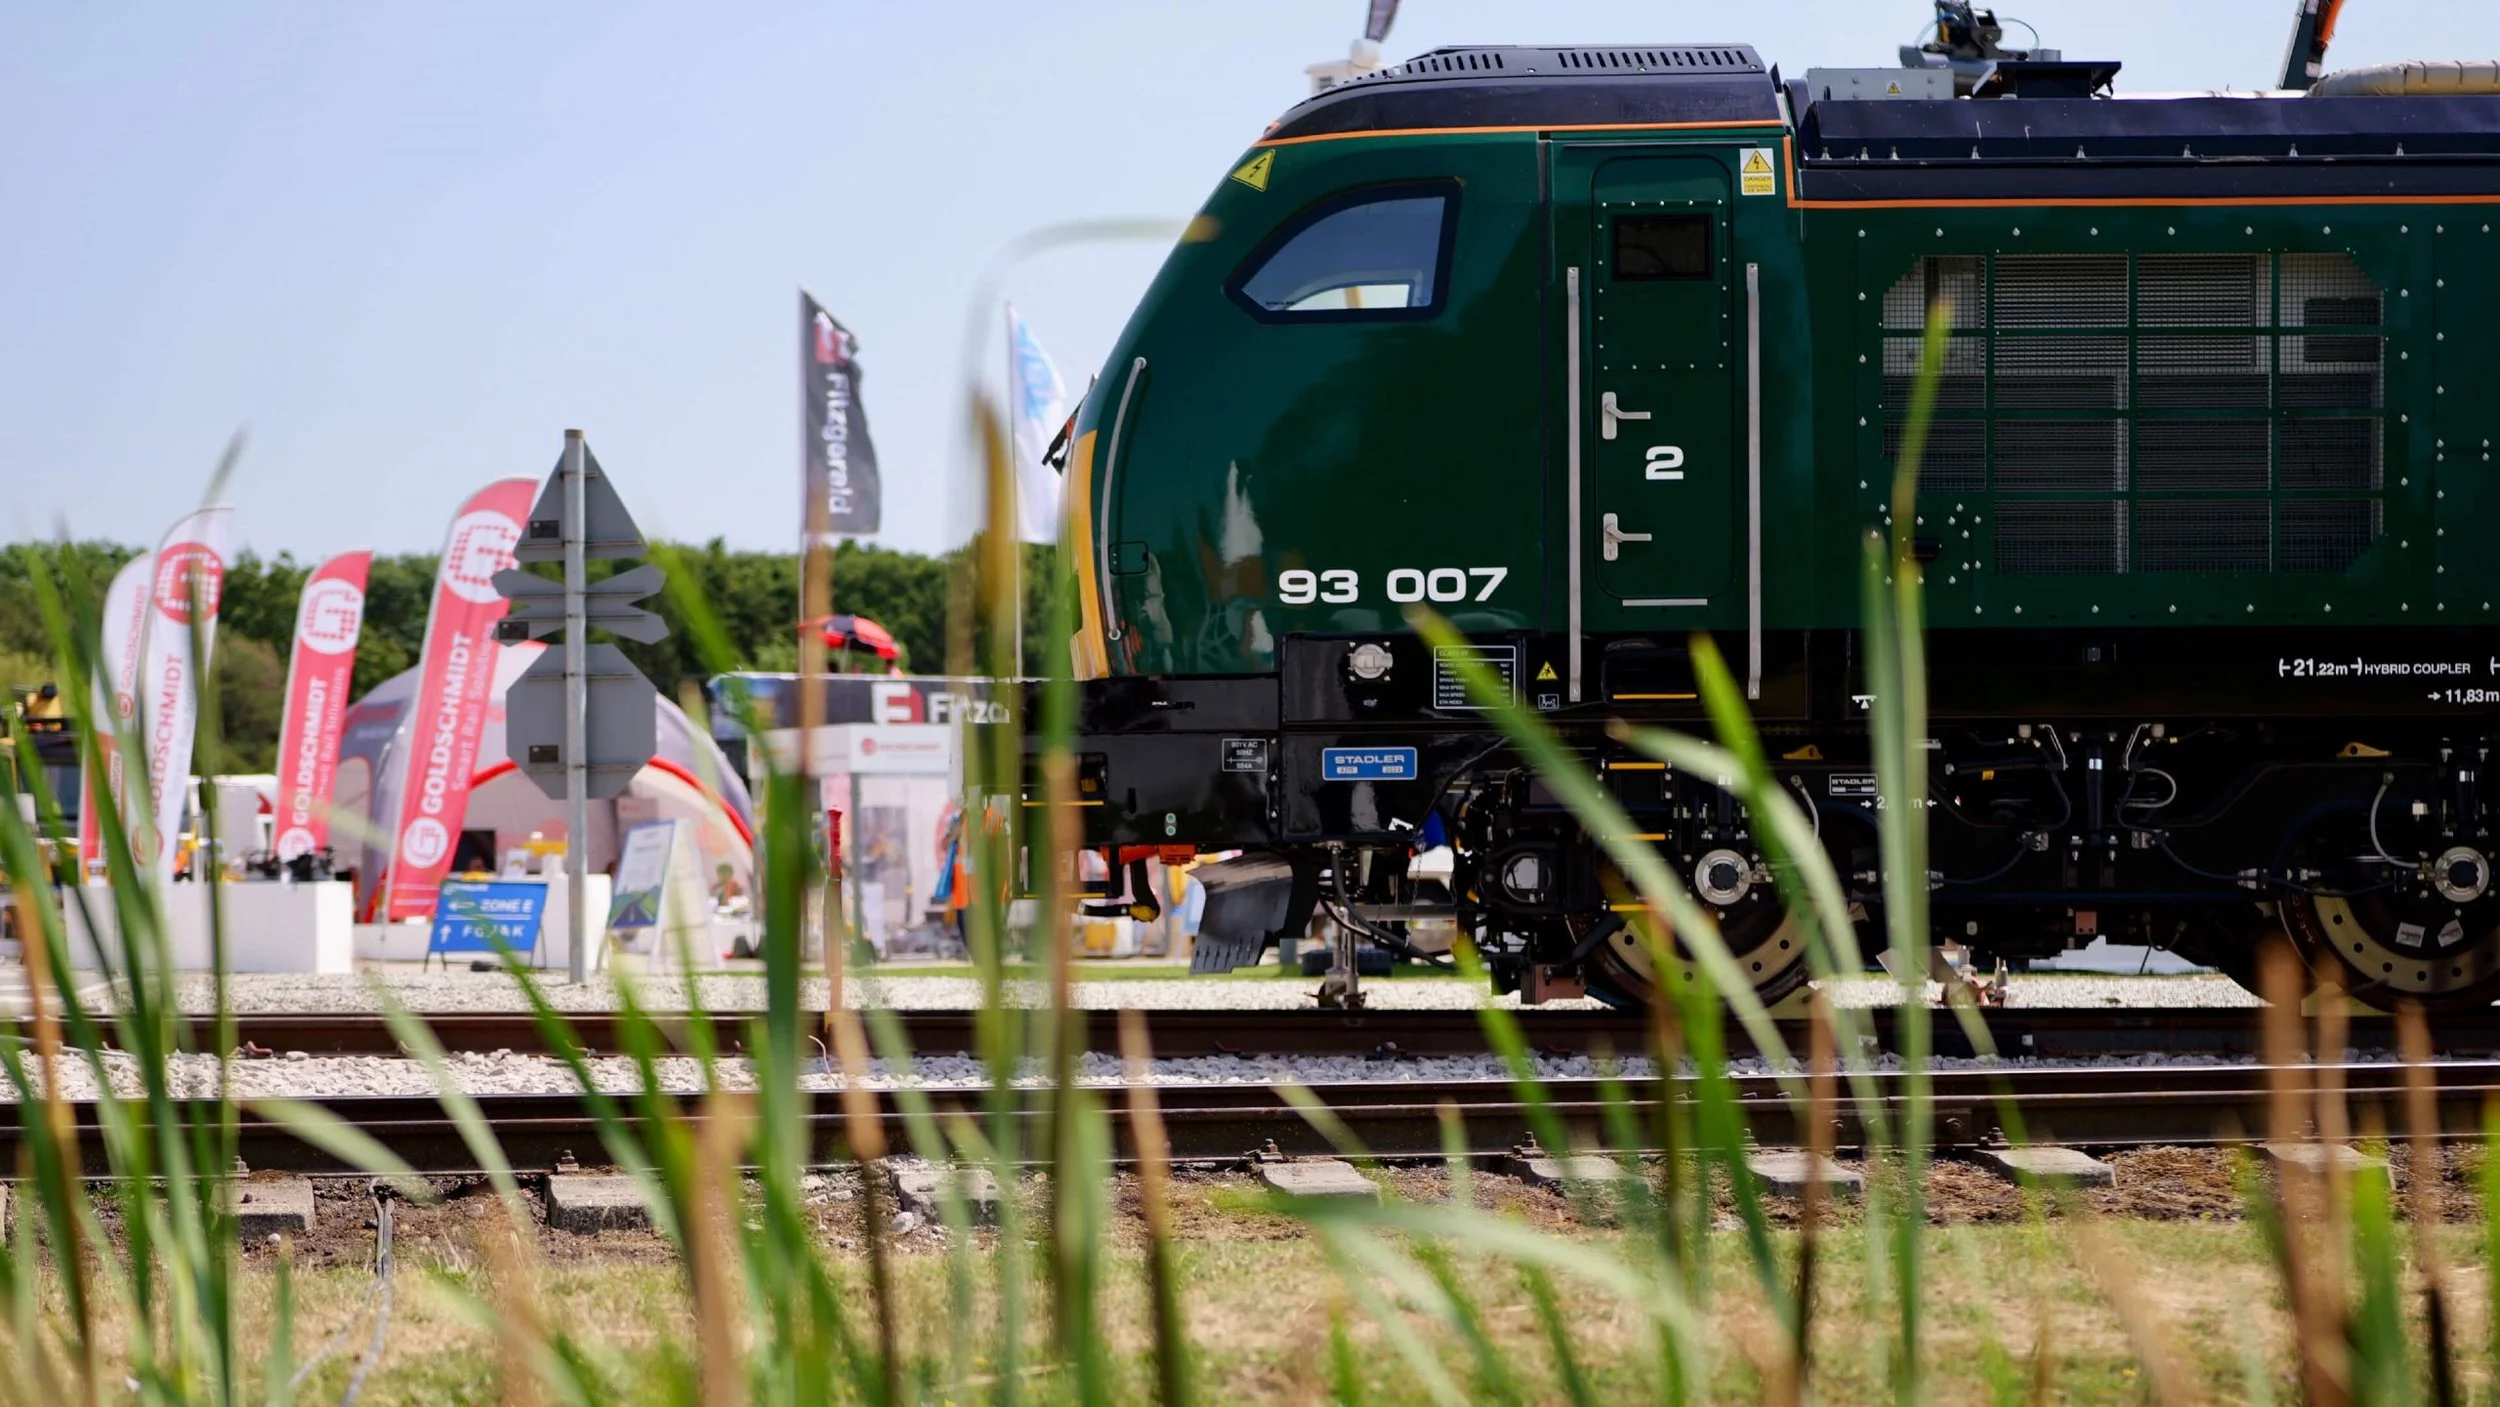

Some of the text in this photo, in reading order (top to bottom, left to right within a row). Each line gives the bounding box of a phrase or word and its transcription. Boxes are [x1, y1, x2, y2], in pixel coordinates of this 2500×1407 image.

[821, 372, 853, 515] Fitzgerald
[1645, 445, 1684, 480] 2
[1278, 566, 1508, 604] 93 007
[2364, 663, 2471, 675] HYBRID COUPLER
[151, 653, 186, 816] GOLDSCHMIDT
[420, 631, 472, 815] GOLDSCHMIDT
[291, 676, 329, 827] GOLDSCHMIDT
[1334, 755, 1404, 764] STADLER
[480, 898, 535, 913] ZONE E
